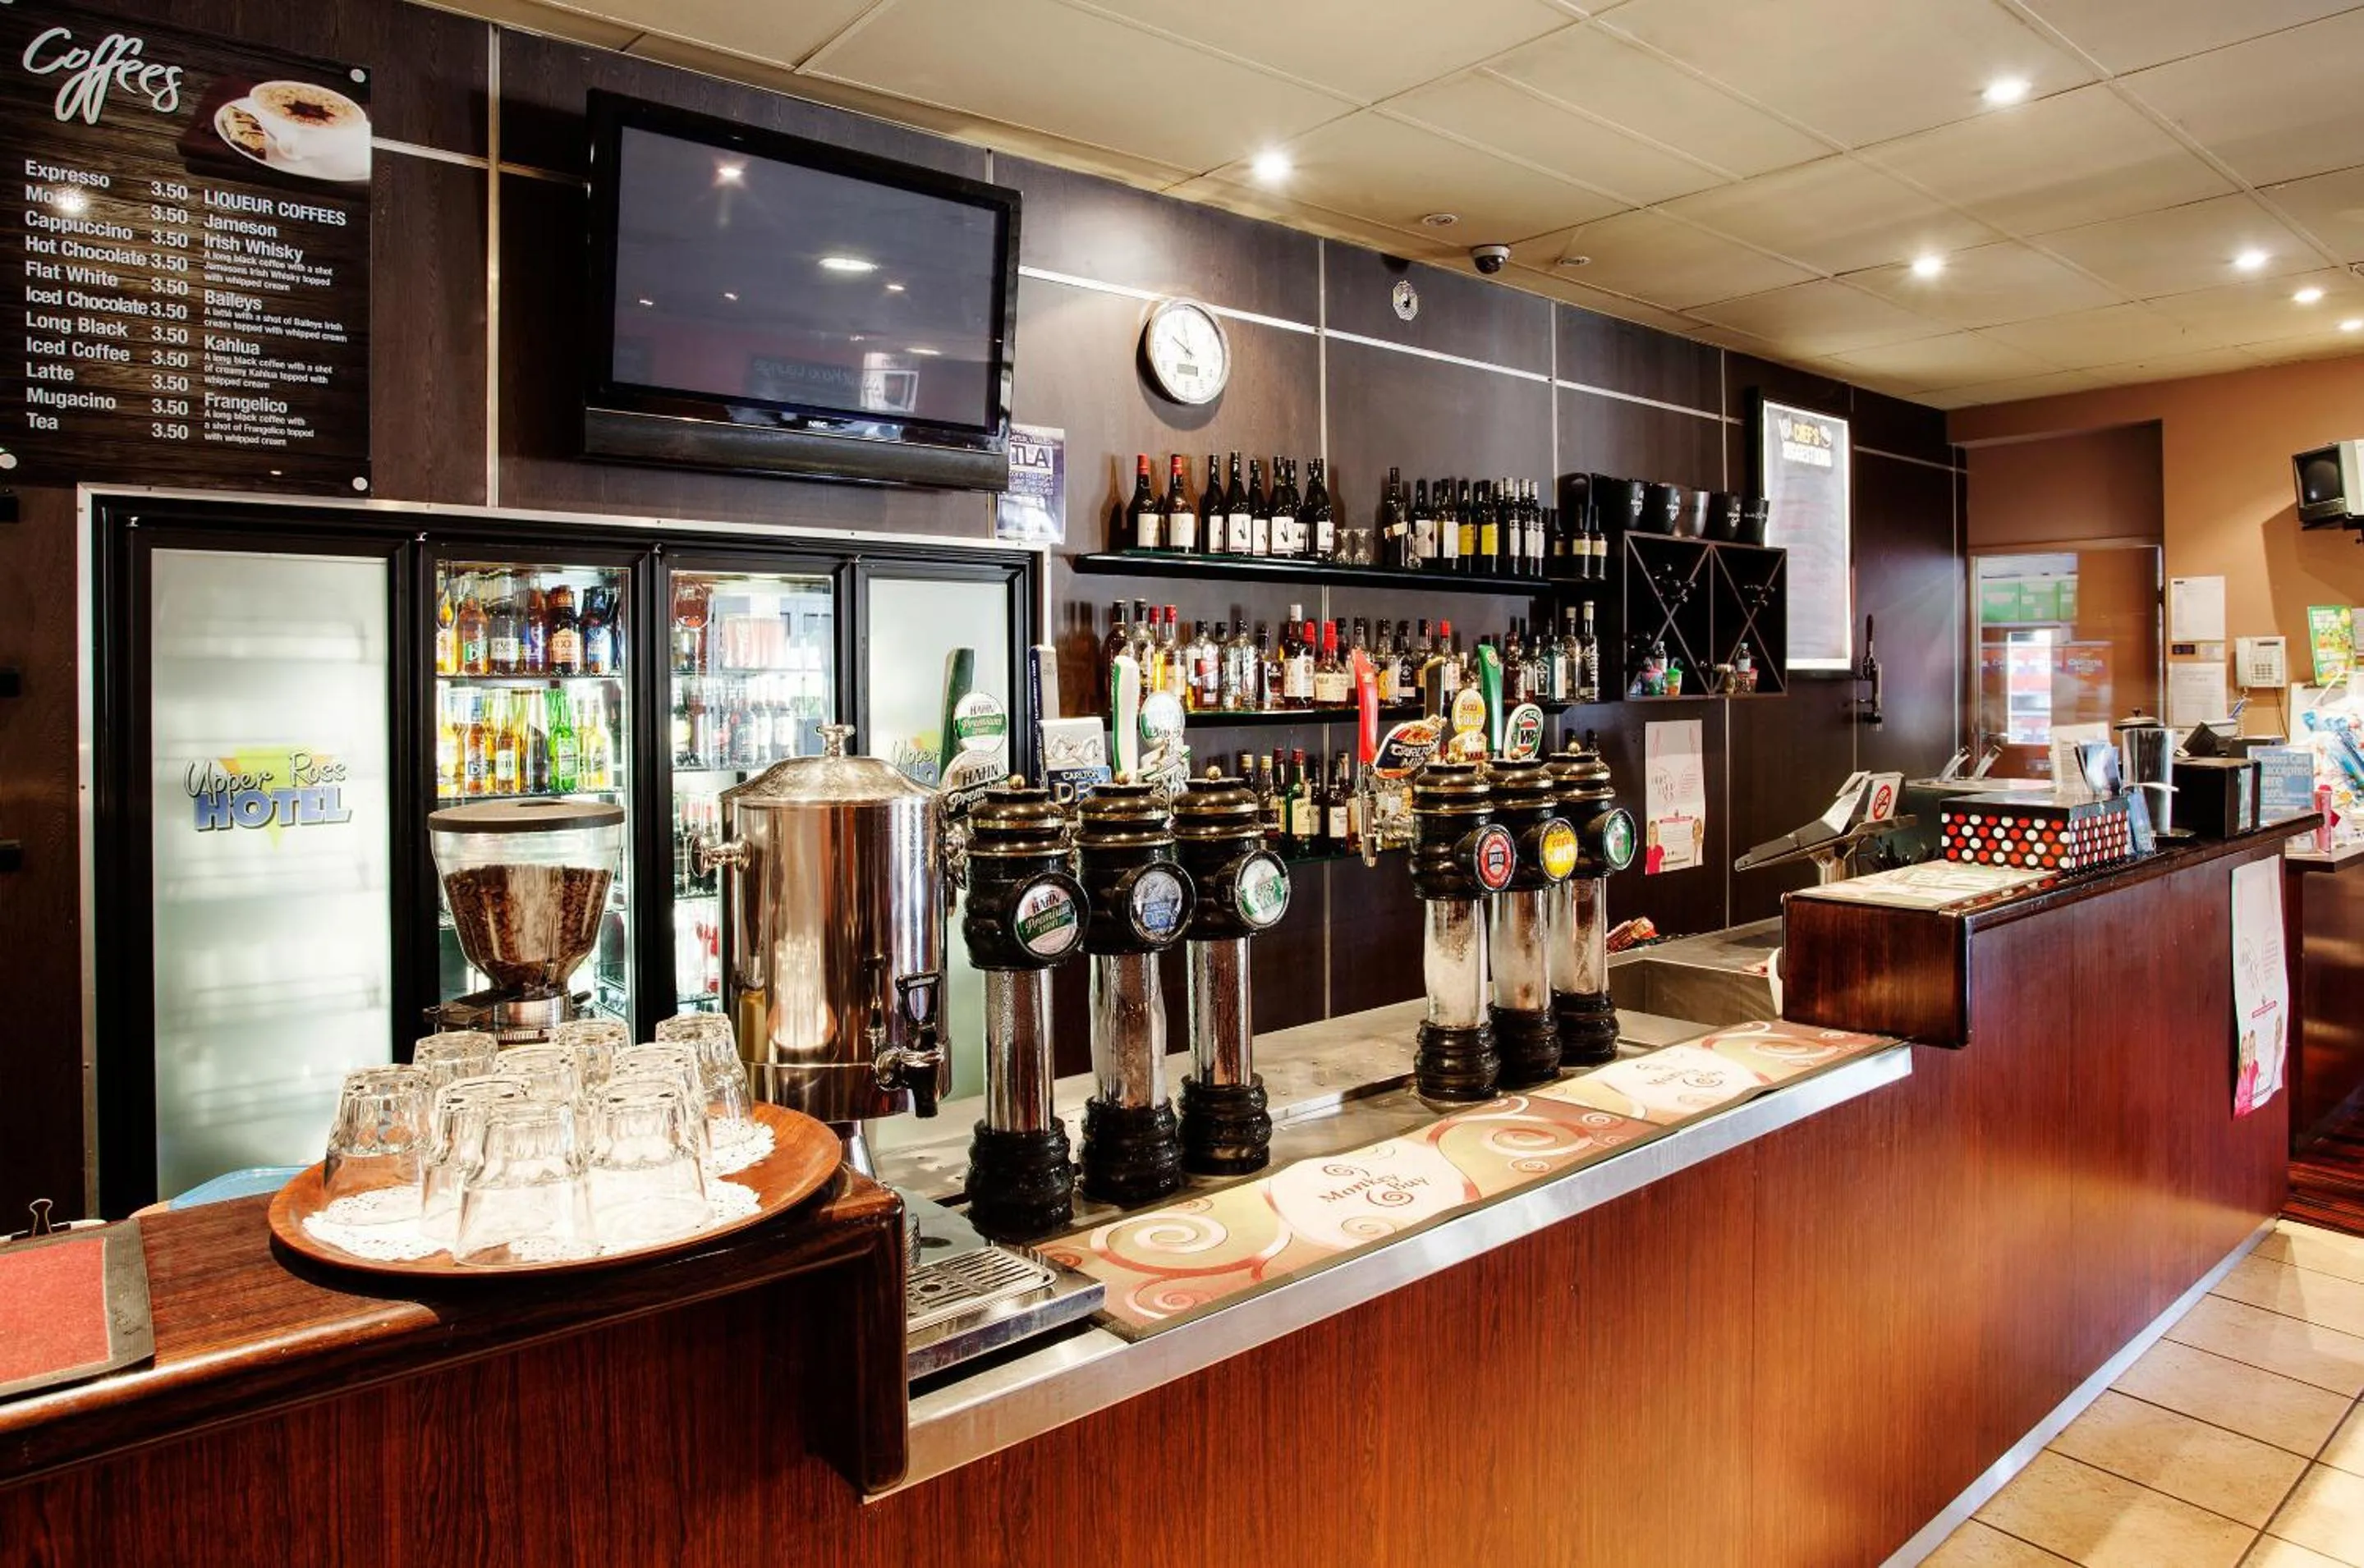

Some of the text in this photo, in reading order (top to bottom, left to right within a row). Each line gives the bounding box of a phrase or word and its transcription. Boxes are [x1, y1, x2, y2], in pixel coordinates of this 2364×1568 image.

[23, 27, 183, 125] Coffees
[25, 159, 189, 200] Expresso 3.50
[150, 204, 189, 224] 3.50
[204, 189, 347, 226] LIQUEUR COFFEES
[25, 210, 189, 248] Cappuccino 3.50
[204, 213, 278, 237] Jameson
[25, 235, 189, 273] Hot Chocolate 3.50
[204, 233, 304, 264] Irish Whisky
[25, 261, 189, 296] Flat White 3.50
[26, 285, 188, 320] Iced Chocolate 3.50
[204, 289, 263, 311] Baileys
[26, 310, 189, 344] Long Black 3.50
[26, 336, 189, 368] Iced Coffee 3.50
[204, 334, 260, 355] Kahlua
[26, 361, 189, 392] Latte 3.50
[26, 387, 189, 415] Mugacino 3.50
[204, 392, 287, 414] Frangelico
[26, 412, 189, 440] Tea 3.50
[184, 750, 347, 807] Upper Ross
[962, 763, 1000, 786] HAHN
[194, 786, 353, 832] HOTEL
[1318, 1173, 1400, 1204] Monkey
